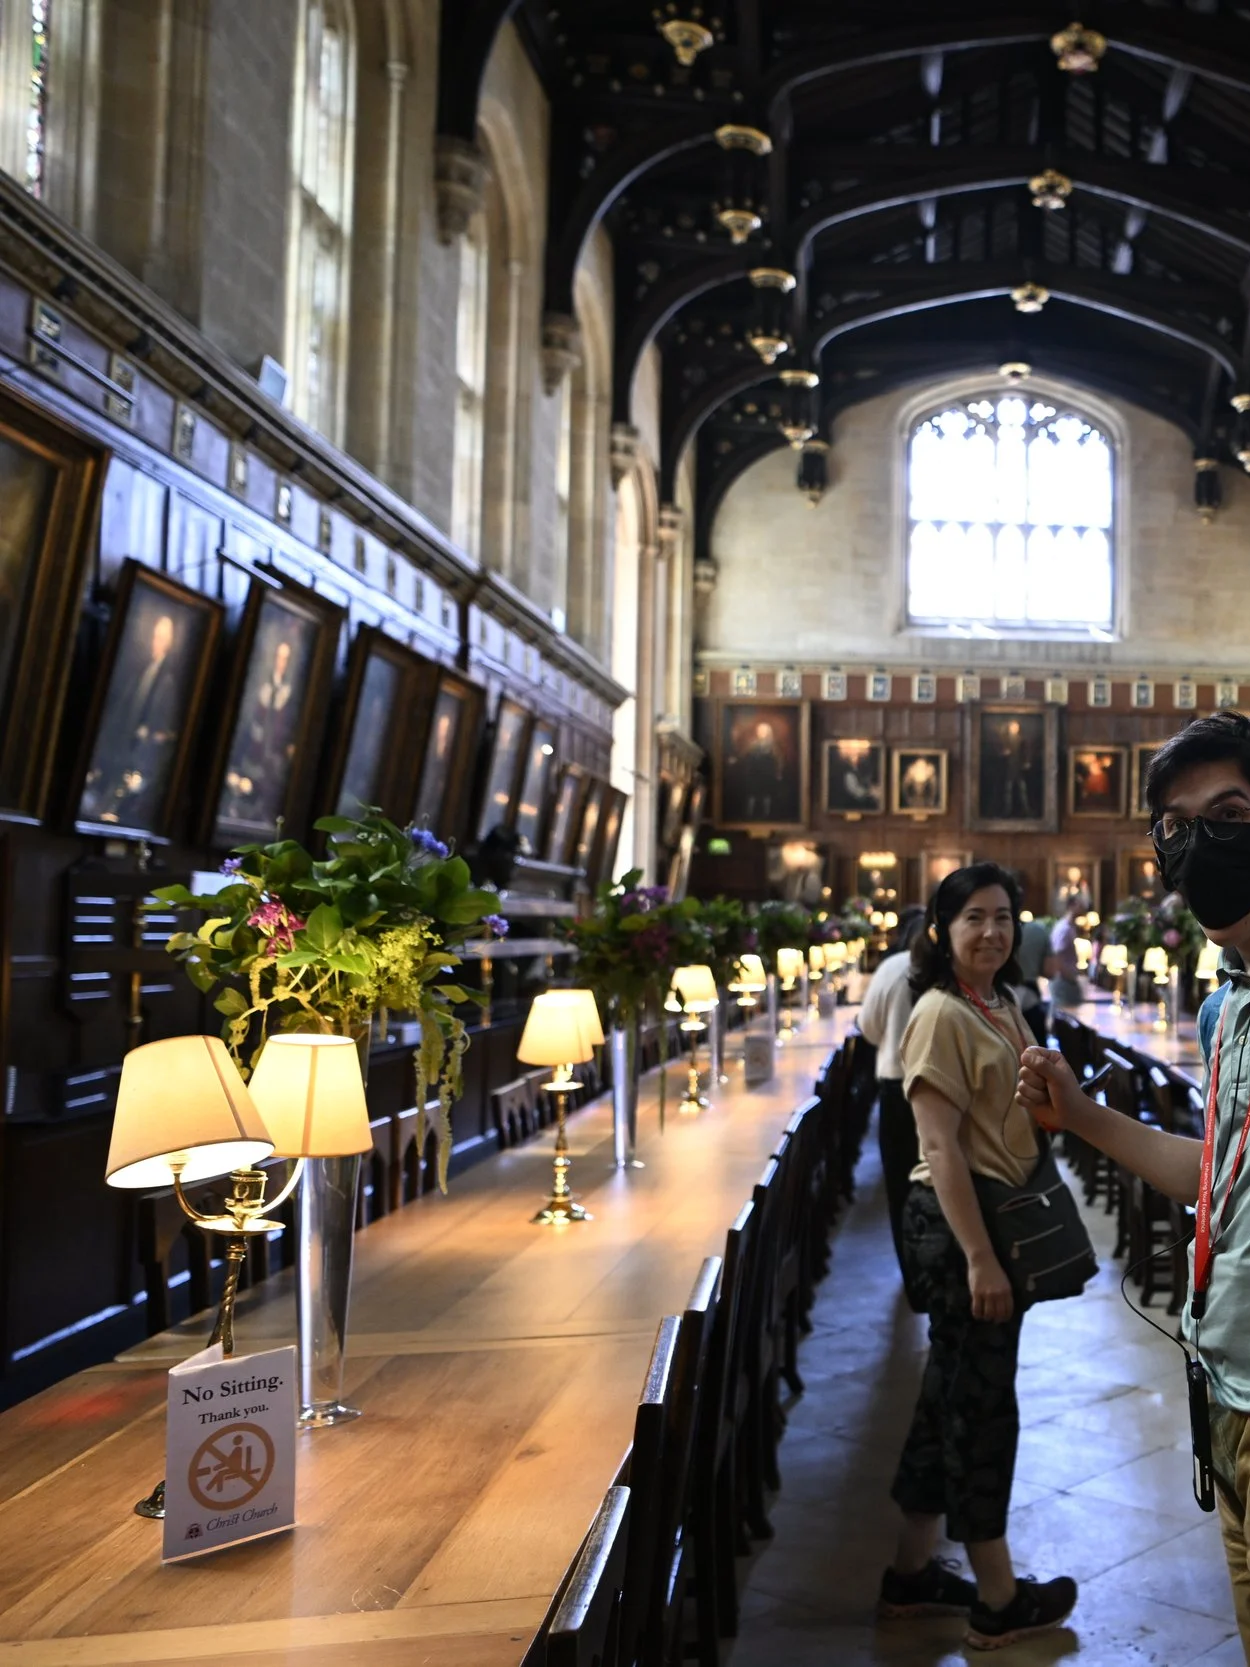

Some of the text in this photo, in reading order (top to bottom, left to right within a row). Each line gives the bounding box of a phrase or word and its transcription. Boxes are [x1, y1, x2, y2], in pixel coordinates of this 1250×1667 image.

[1202, 1162, 1210, 1191] Enhancing
[1200, 1203, 1208, 1234] Experience
[182, 1375, 284, 1405] No Sitting.
[198, 1404, 269, 1425] Thank you.
[206, 1502, 278, 1532] Christ Church
